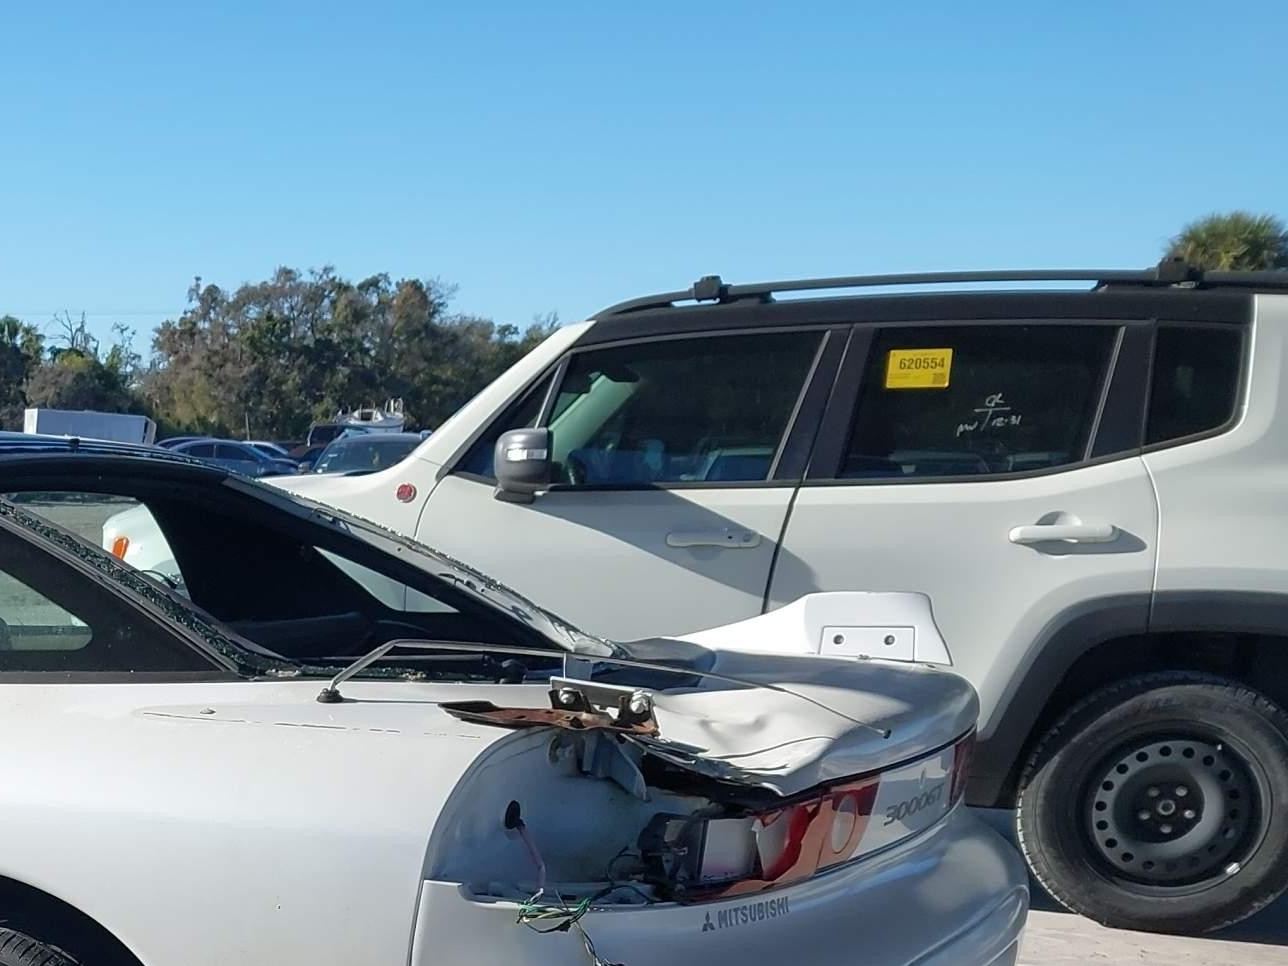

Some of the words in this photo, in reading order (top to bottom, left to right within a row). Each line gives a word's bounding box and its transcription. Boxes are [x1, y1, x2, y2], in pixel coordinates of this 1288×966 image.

[898, 356, 945, 370] 620554
[883, 782, 945, 826] 3000GT
[717, 896, 790, 929] MITSUBISHI
